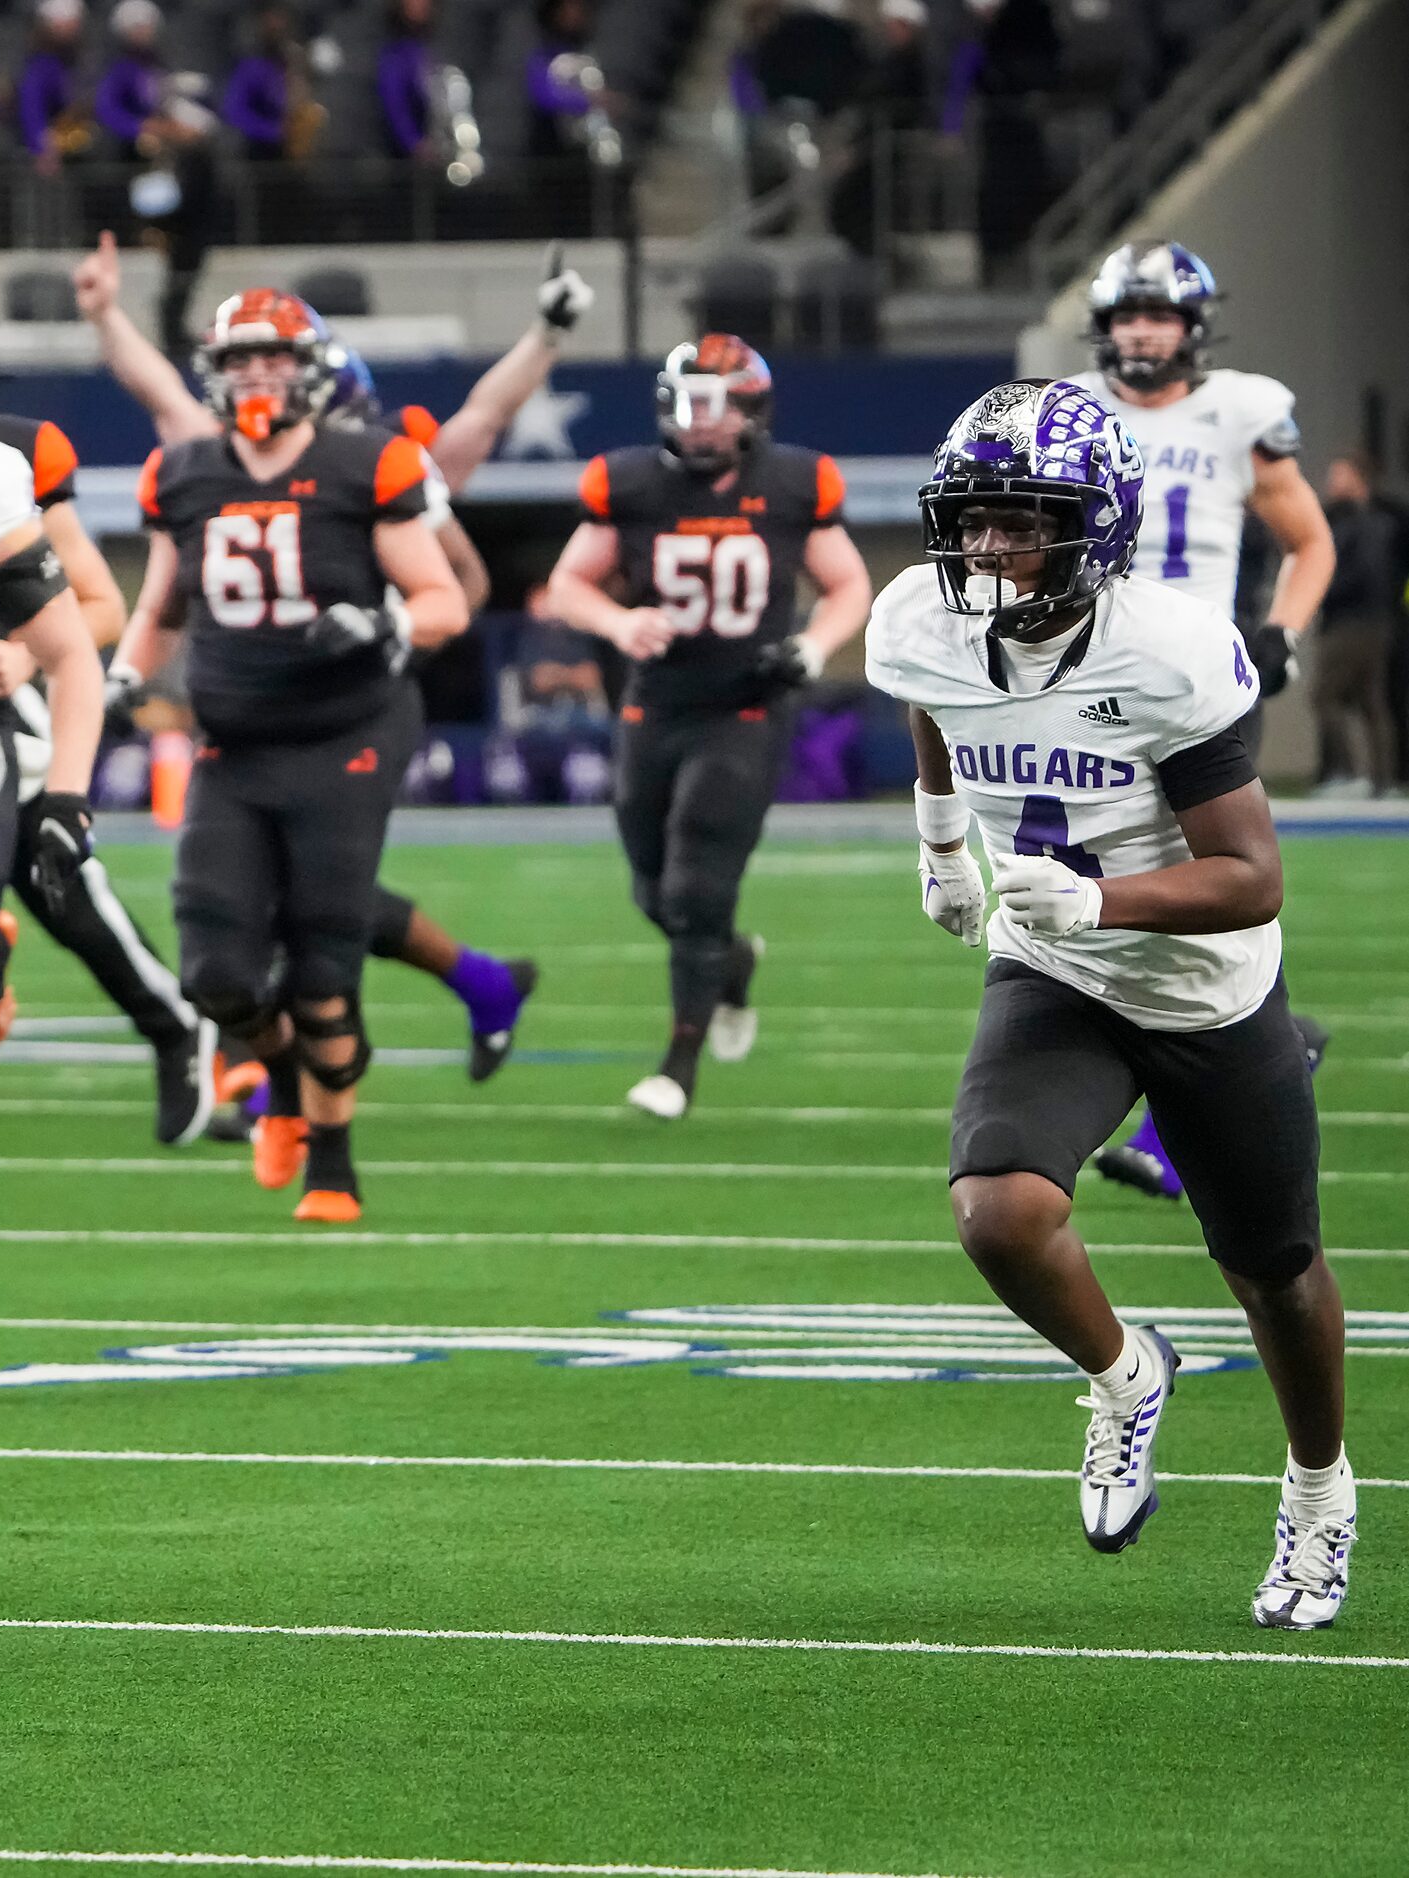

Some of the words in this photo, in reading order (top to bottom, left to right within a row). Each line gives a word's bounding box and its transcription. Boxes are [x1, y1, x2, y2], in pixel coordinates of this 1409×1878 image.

[203, 512, 318, 628] 61
[1162, 484, 1190, 579] 1
[653, 532, 771, 639] 50
[1232, 639, 1253, 690] 4
[1078, 708, 1130, 726] adidas
[948, 743, 1136, 789] OUGARS
[1013, 793, 1105, 879] 4
